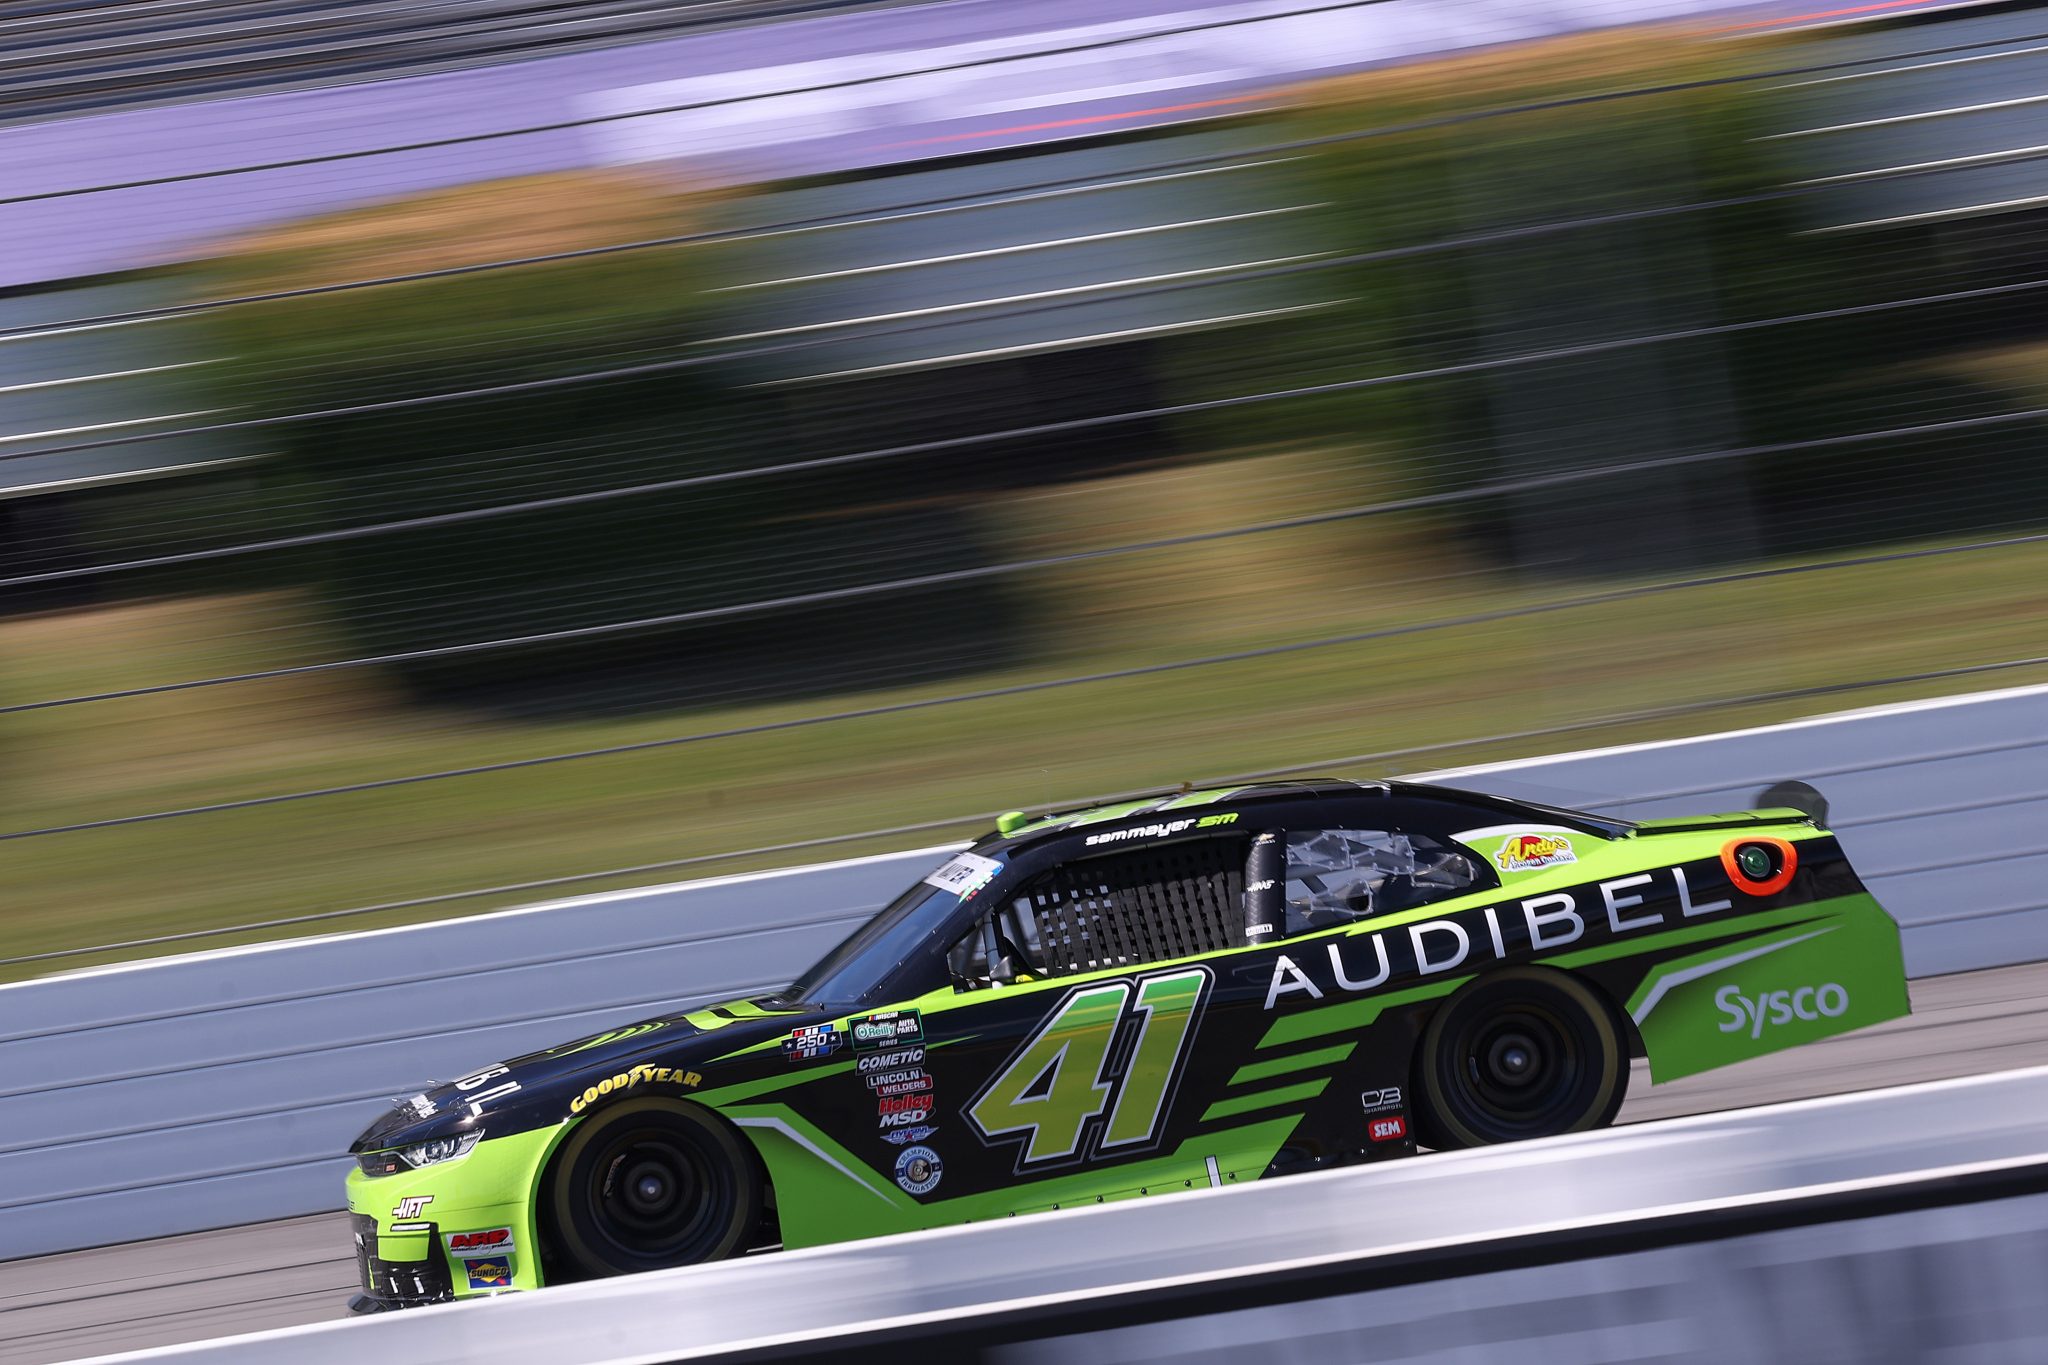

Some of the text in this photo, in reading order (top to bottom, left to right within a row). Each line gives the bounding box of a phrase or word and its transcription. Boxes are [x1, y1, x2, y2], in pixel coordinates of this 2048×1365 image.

[1264, 866, 1732, 1010] AUDIBEL
[1714, 982, 1849, 1039] Sysco
[856, 1022, 896, 1039] O'Reilly
[897, 1024, 919, 1034] PARTS
[898, 1018, 916, 1027] AUTO
[797, 1033, 828, 1050] 250
[858, 1047, 924, 1071] COMETIC
[969, 969, 1206, 1164] 41
[869, 1070, 921, 1087] LINCOLN
[570, 1063, 703, 1113] GOODYEAR
[882, 1080, 927, 1095] WELDERS
[879, 1094, 933, 1115] Holley
[879, 1110, 927, 1128] MSD
[1374, 1120, 1401, 1137] SEM
[899, 1149, 935, 1166] CHAMPION
[451, 1229, 509, 1248] ARP
[470, 1267, 508, 1278] SUNOCO
